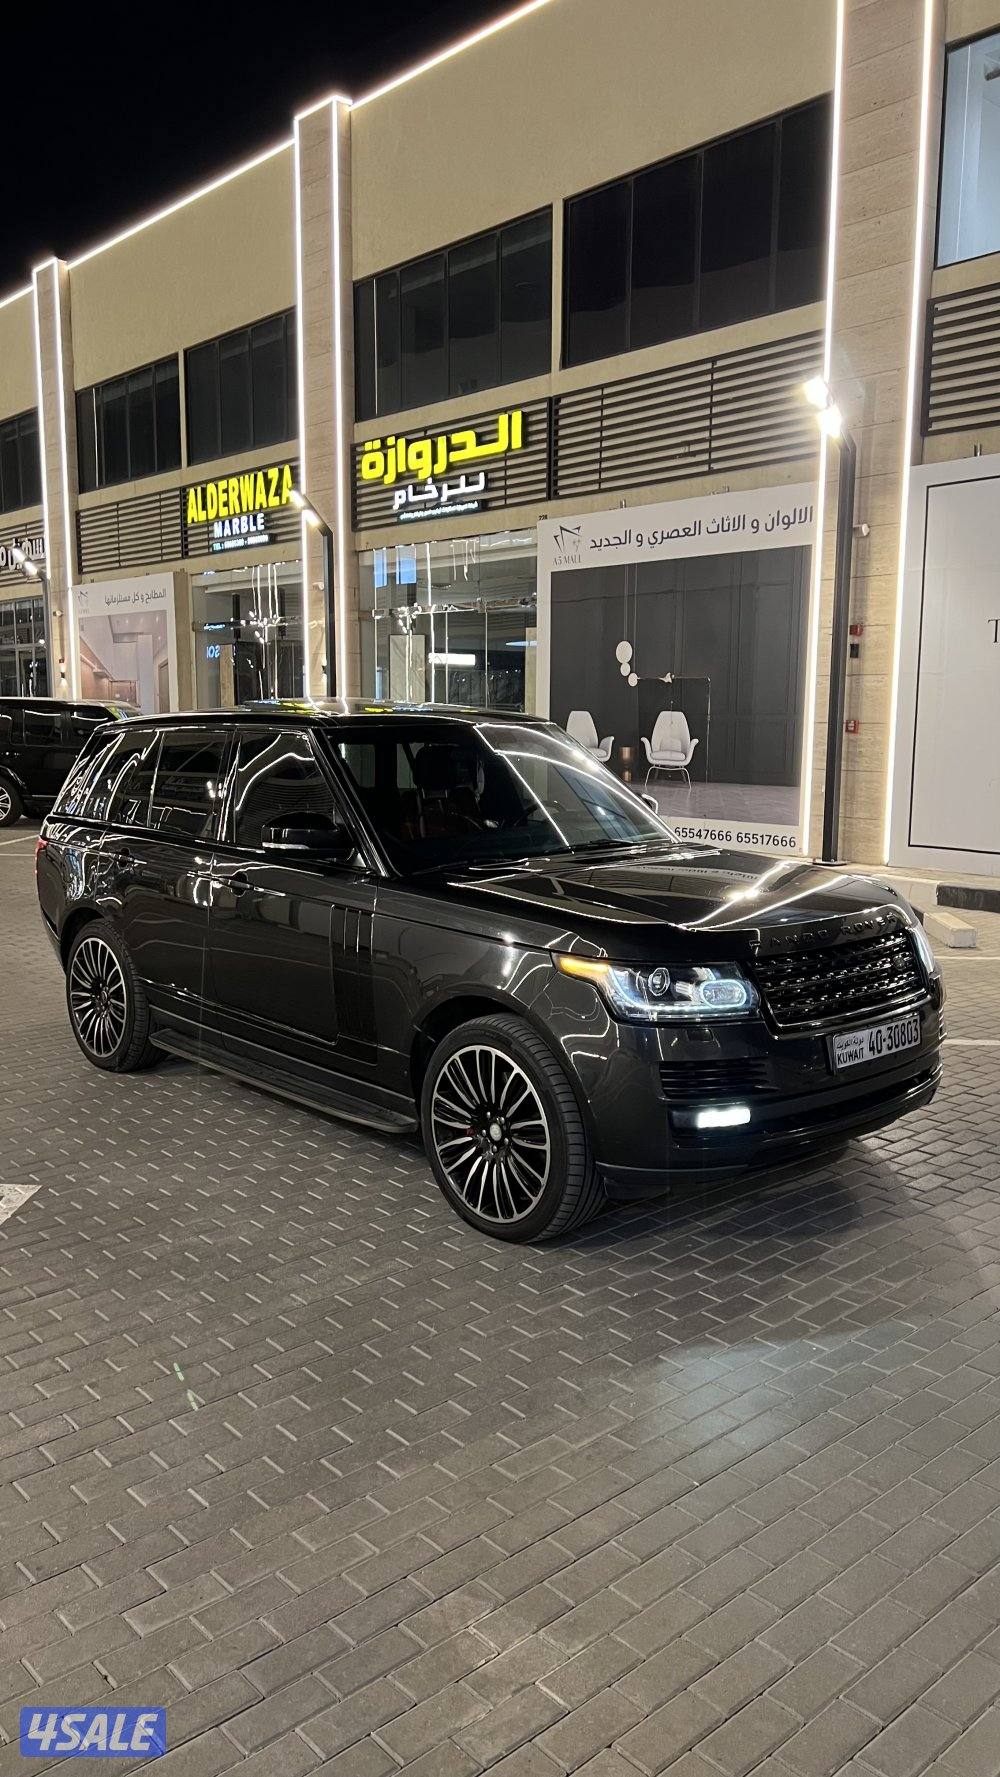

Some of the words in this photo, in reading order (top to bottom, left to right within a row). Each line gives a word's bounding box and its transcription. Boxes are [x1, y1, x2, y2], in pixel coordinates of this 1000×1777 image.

[361, 410, 522, 485] الدروازة
[187, 464, 293, 524] ALDERWAZA
[393, 472, 485, 510] للرخام
[213, 513, 265, 538] MARBLE
[648, 520, 702, 549] العصري
[751, 518, 759, 533] و
[590, 529, 632, 551] الجديد
[636, 533, 643, 547] و
[674, 826, 732, 842] 65547666
[736, 832, 796, 848] 65517666
[868, 1018, 919, 1056] 40-30803
[837, 1047, 864, 1066] KUWAIT
